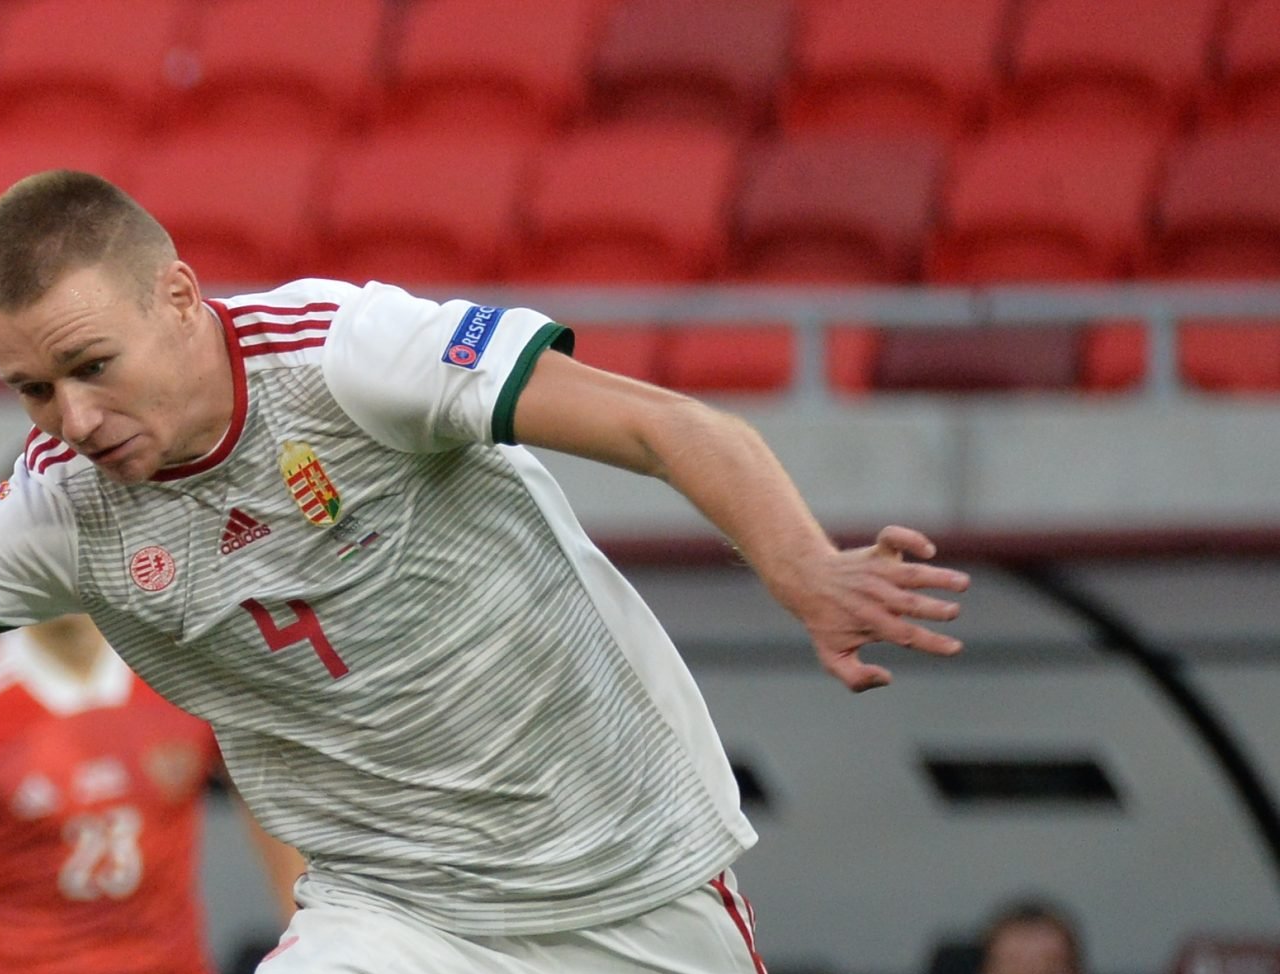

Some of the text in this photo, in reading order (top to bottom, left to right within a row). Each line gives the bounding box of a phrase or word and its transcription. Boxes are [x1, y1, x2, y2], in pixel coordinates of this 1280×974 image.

[461, 306, 496, 347] RESPEC
[221, 523, 272, 555] adidas
[238, 597, 350, 680] 4
[58, 806, 143, 900] 23
